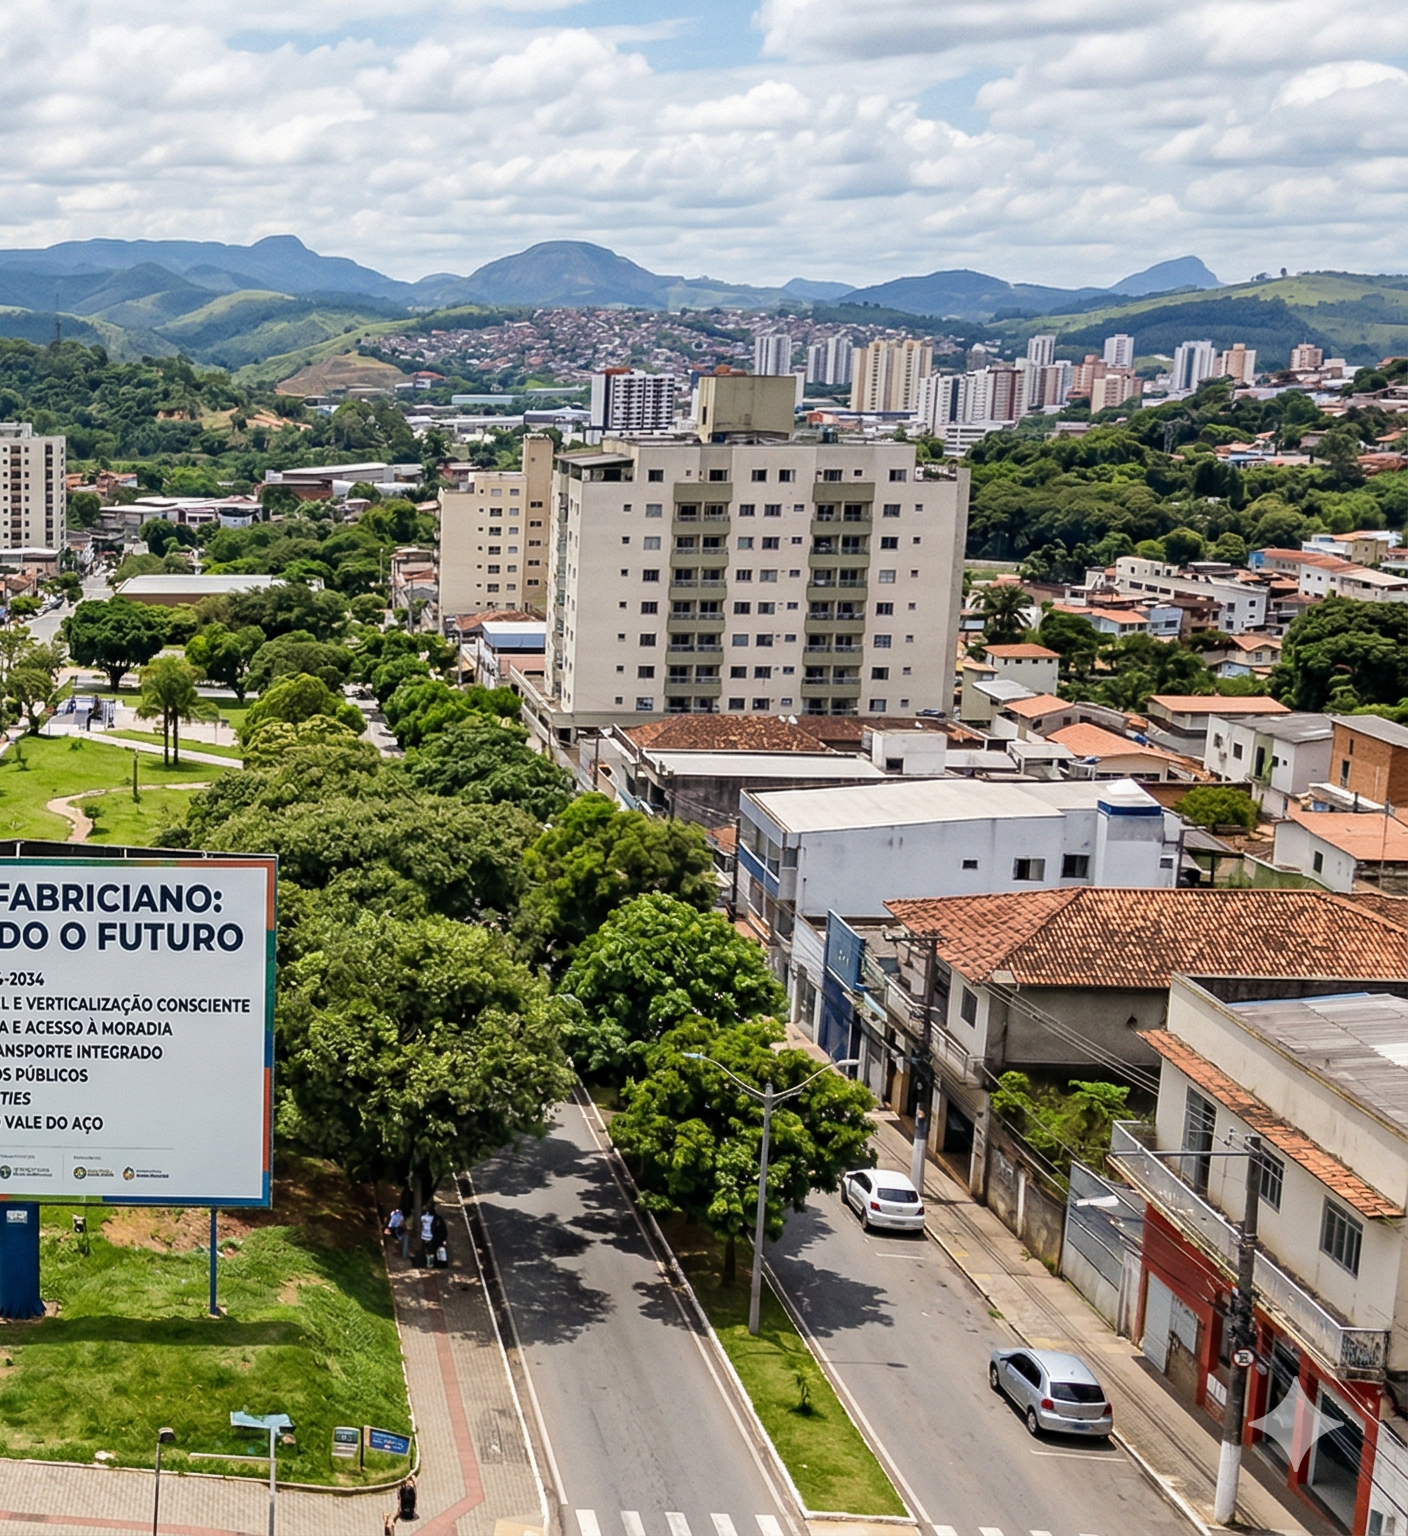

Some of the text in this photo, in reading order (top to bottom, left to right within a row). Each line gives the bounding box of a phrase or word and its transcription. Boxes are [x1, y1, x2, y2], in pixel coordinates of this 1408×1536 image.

[60, 922, 86, 950] O
[99, 922, 243, 951] FUTURO
[13, 996, 22, 1010] E
[26, 993, 152, 1016] VERTICALIZAÇÃO
[157, 998, 250, 1013] CONSCIENTE
[13, 1020, 22, 1034] E
[25, 1020, 83, 1035] ACESSO
[87, 1016, 98, 1035] À
[102, 1021, 172, 1036] MORADIA
[76, 1045, 163, 1059] INTEGRADO
[16, 1064, 88, 1082] PÚBLICOS
[4, 1115, 41, 1130] VALE
[46, 1116, 68, 1130] DO
[72, 1117, 103, 1134] AÇO
